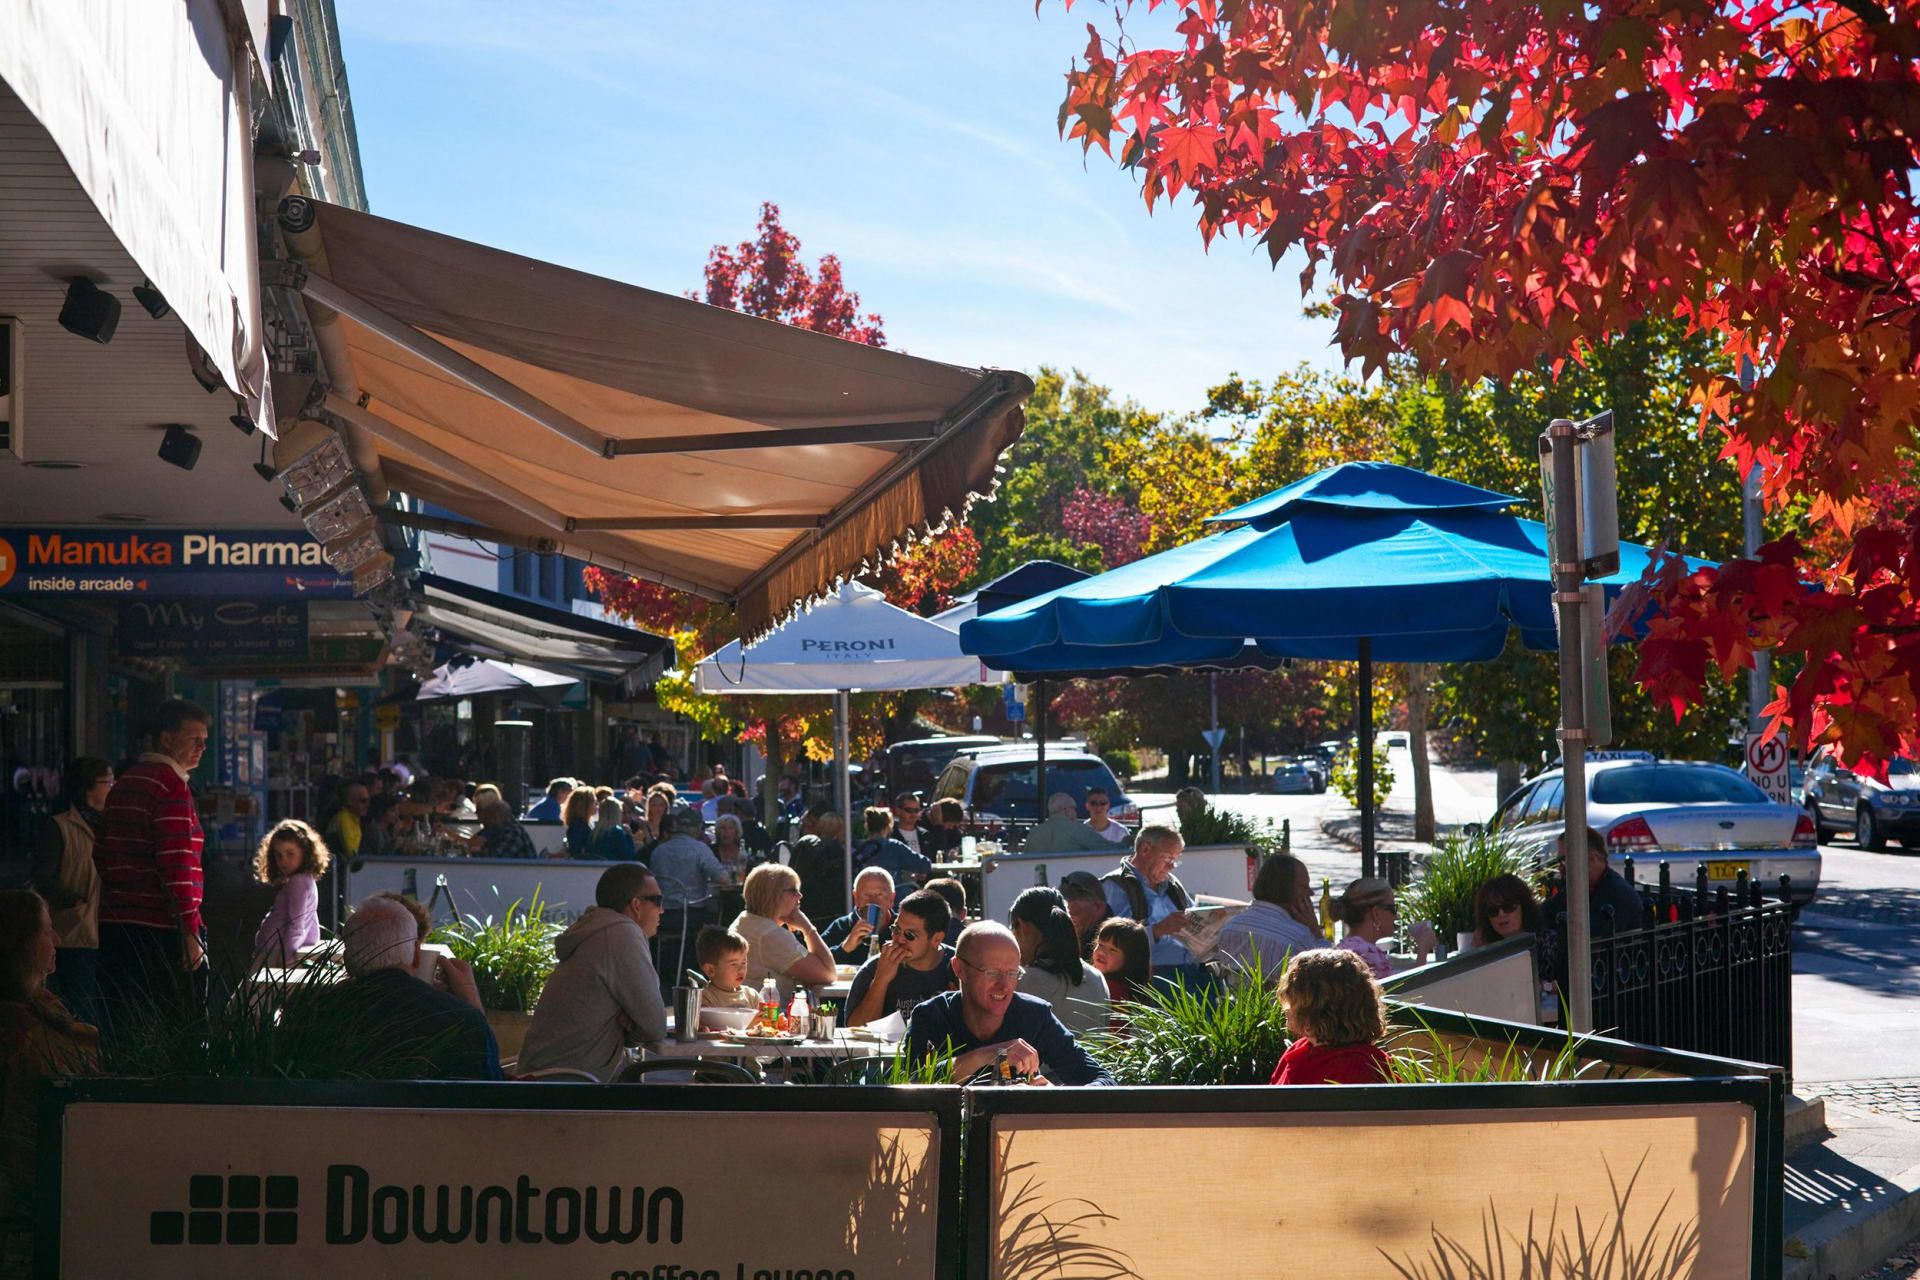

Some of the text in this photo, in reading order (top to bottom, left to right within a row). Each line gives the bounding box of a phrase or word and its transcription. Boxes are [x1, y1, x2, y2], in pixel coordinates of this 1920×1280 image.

[28, 535, 172, 565] Manuka
[29, 577, 134, 591] inside arcade
[131, 602, 300, 629] My Cafe
[801, 638, 895, 652] PERONI
[1592, 752, 1622, 760] TAXI
[1751, 775, 1786, 789] NO U
[326, 1164, 684, 1245] Downtown
